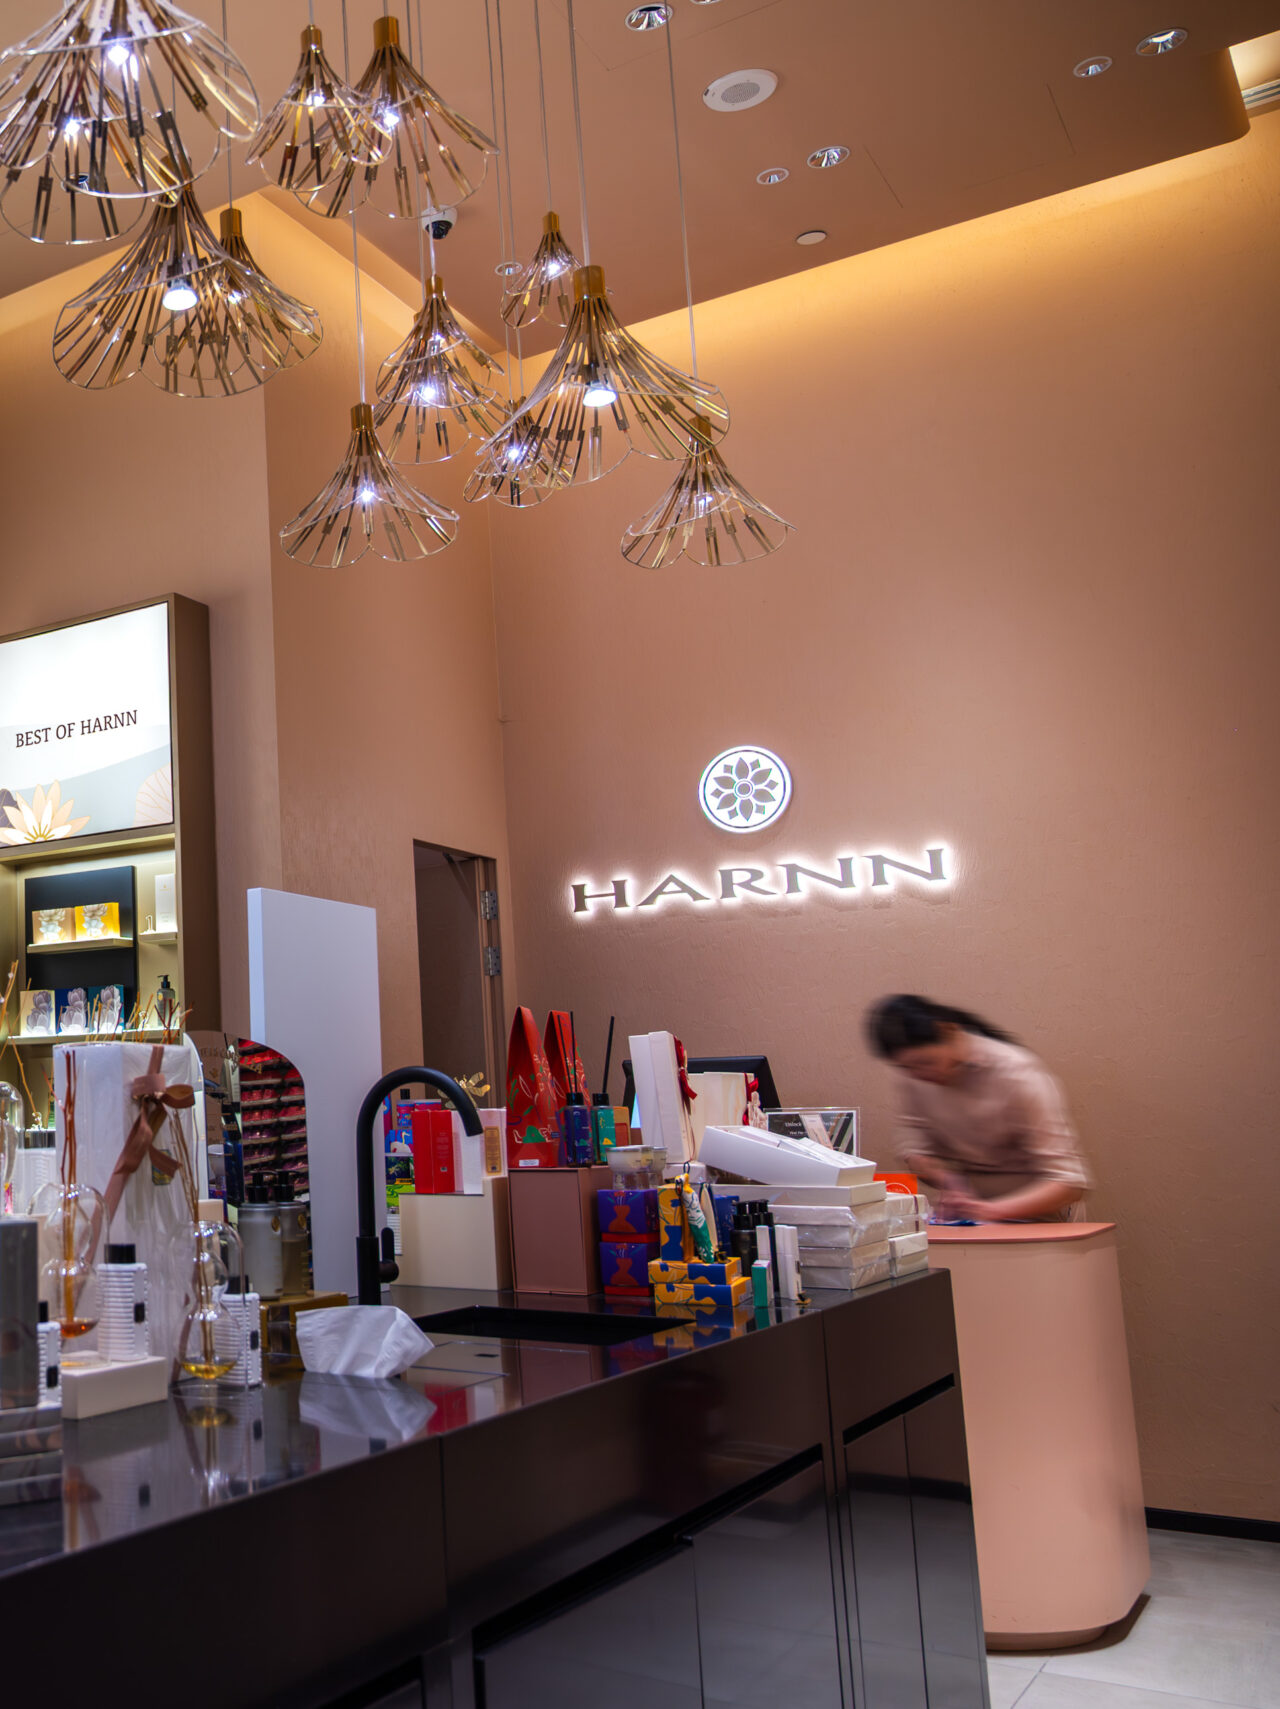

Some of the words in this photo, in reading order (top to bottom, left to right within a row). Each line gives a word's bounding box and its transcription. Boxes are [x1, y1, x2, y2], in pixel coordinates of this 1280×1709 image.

[15, 727, 51, 748] BEST
[55, 722, 75, 740] OF
[80, 709, 138, 735] HARNN
[570, 848, 947, 913] HARNN
